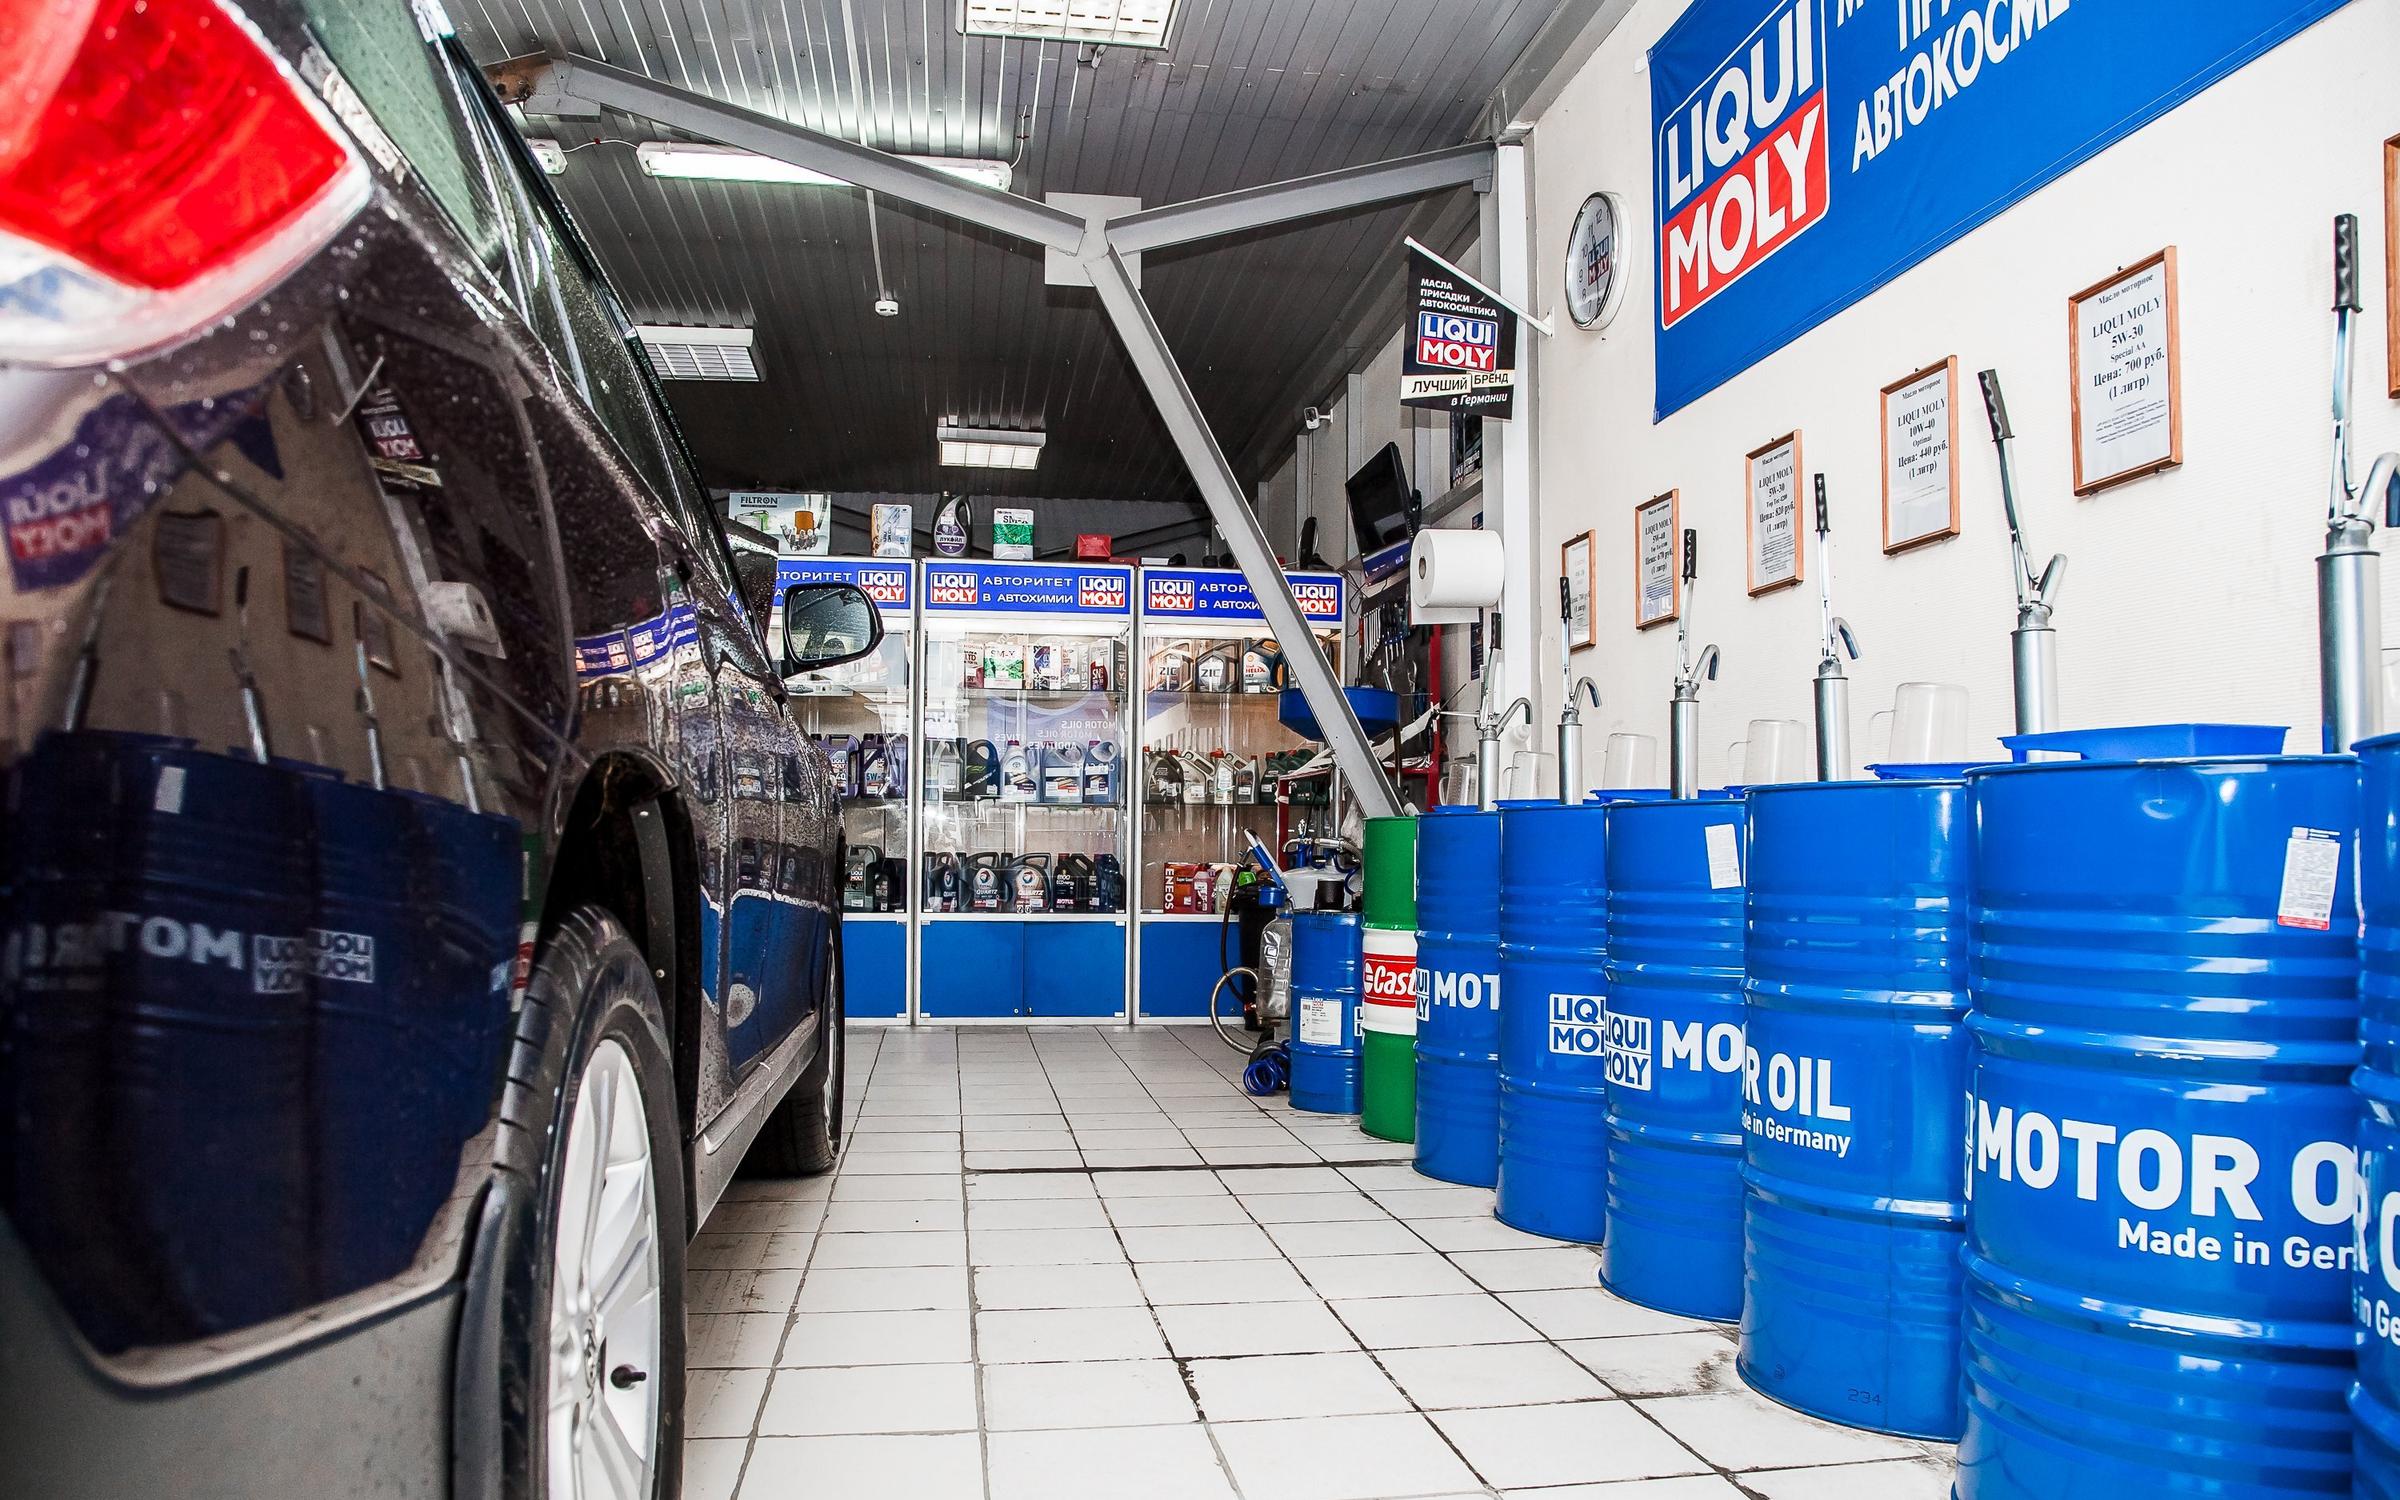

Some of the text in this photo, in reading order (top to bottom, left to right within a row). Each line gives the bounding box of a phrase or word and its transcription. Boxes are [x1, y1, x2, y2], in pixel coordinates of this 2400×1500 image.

[1668, 0, 1813, 211] LIQUI
[1669, 104, 1821, 310] MOLY
[1421, 278, 1453, 290] МАСЛА
[2098, 273, 2153, 305] Масло моторное
[1420, 288, 1470, 303] ПРИСАДКИ
[1420, 298, 1497, 317] АВТОКОСМЕТИКА
[2092, 295, 2162, 339] LIQUI MOLY
[1424, 315, 1492, 345] LIQUI
[2111, 323, 2144, 349] 5W-30
[1422, 340, 1493, 369] MOLY
[2110, 347, 2134, 364] Special
[2093, 347, 2165, 388] Цена: 700 руб.
[1411, 372, 1509, 394] ЛУЧШИЙ БРЕНД
[2108, 373, 2150, 402] (1 литр)
[1451, 392, 1508, 407] в Германии
[1897, 397, 1946, 428] LIQUI MOLY
[1909, 417, 1936, 438] 10W-40
[1912, 433, 1932, 448] Optimal
[1898, 439, 1948, 469] Цена: 440 руб.
[1759, 465, 1793, 488] LIQUI MOLY
[1908, 460, 1938, 481] (1 литр)
[1769, 483, 1785, 498] 5W-30
[741, 496, 778, 505] FILTRON
[1760, 511, 1774, 524] Цена:
[861, 572, 903, 587] LIQUI
[933, 573, 976, 588] LIQUI
[983, 576, 1073, 588] АВТОРИТЕТ
[1081, 578, 1123, 593] LIQUI
[1152, 580, 1192, 594] LIQUI
[933, 587, 977, 603] MOLY
[983, 594, 1073, 605] В АВТОХИМИИ
[1082, 591, 1125, 606] MOLY
[1293, 584, 1335, 600] LIQUI
[1152, 594, 1194, 609] MOLY
[1200, 600, 1207, 608] В
[1159, 667, 1177, 676] ZIC
[1200, 669, 1220, 678] ZIC
[1165, 868, 1174, 910] ENEOS
[1769, 1053, 1851, 1121] OIL
[1753, 1112, 1763, 1136] in
[1766, 1115, 1851, 1159] Germany
[1977, 1099, 2264, 1221] MOTOR
[2118, 1218, 2222, 1263] Made
[2233, 1231, 2270, 1267] in
